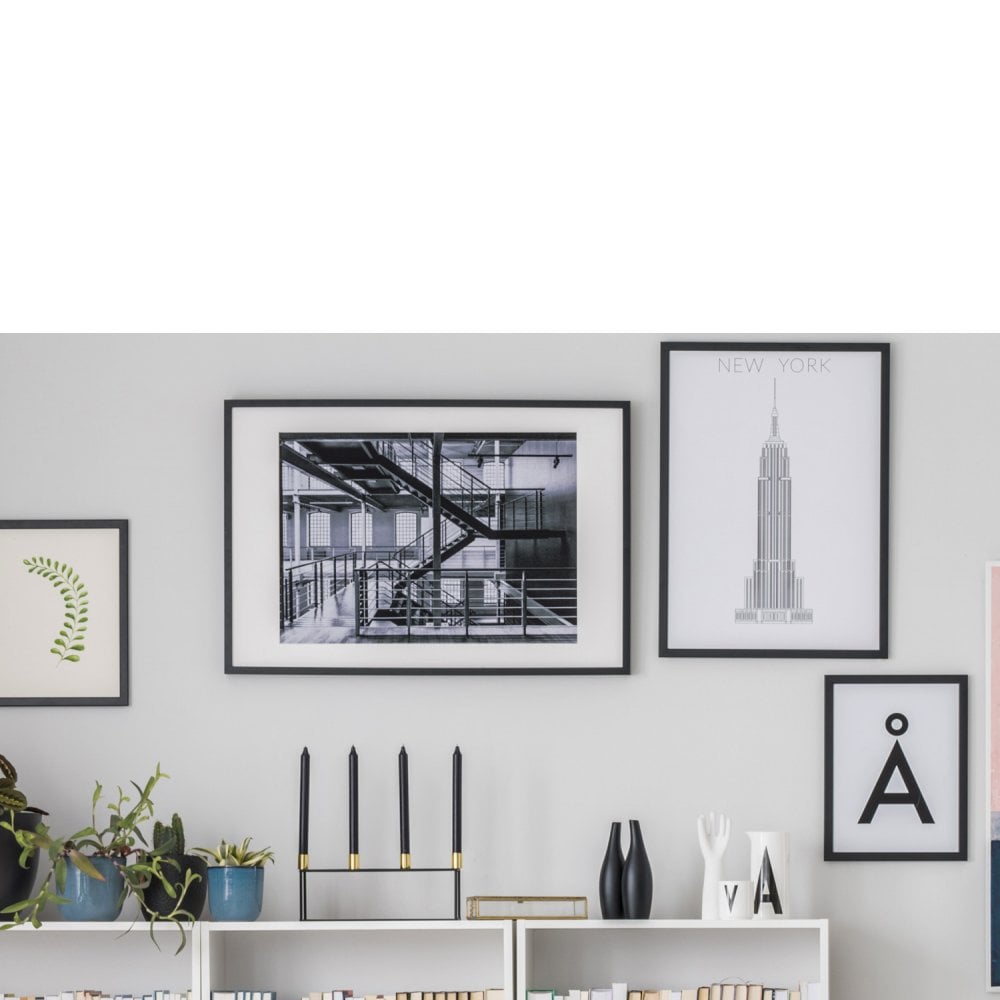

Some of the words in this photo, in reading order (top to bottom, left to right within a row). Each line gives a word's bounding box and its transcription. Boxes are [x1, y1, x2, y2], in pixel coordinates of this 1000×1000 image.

[717, 357, 765, 373] NEW
[778, 357, 832, 373] YORK
[857, 712, 936, 825] Å
[724, 884, 739, 914] V
[753, 845, 783, 915] A
